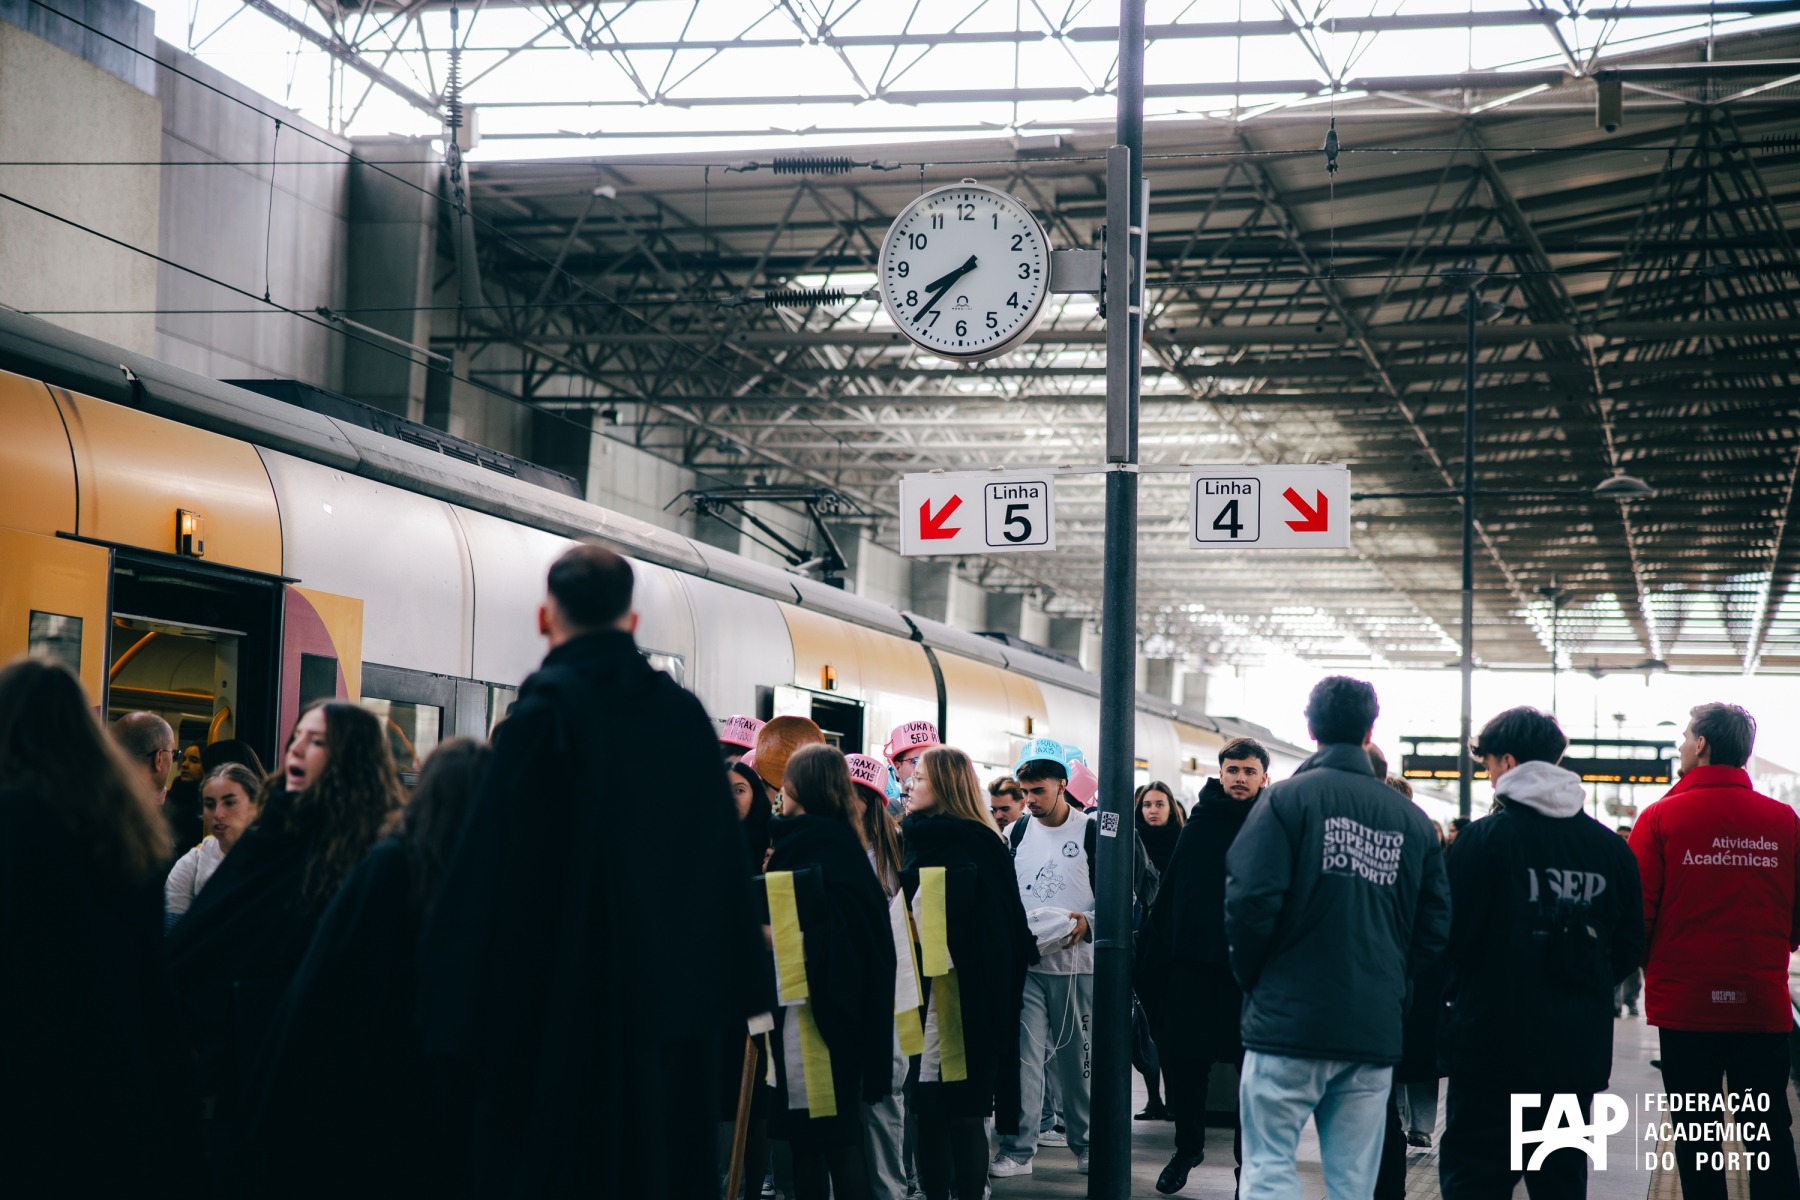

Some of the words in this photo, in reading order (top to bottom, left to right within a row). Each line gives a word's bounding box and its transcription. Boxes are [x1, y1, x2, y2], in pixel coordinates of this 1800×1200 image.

[957, 204, 975, 220] 12
[931, 213, 943, 229] 11
[992, 213, 997, 229] 1
[909, 233, 927, 250] 10
[1011, 234, 1023, 251] 2
[898, 261, 909, 278] 9
[1018, 263, 1030, 279] 3
[906, 290, 918, 306] 8
[1006, 292, 1018, 308] 4
[928, 311, 941, 327] 7
[985, 312, 997, 328] 5
[955, 320, 967, 336] 6
[994, 485, 1038, 499] Linha
[1205, 481, 1251, 494] Linha
[1003, 504, 1032, 542] 5
[1213, 500, 1243, 538] 4
[911, 732, 928, 744] SED
[850, 767, 875, 782] RAXIS
[1325, 817, 1404, 847] INSTITUTO
[1324, 830, 1401, 862] SUPERIOR
[1712, 836, 1778, 850] Atividades
[1682, 849, 1778, 867] Académicas
[1323, 854, 1348, 870] DO
[1351, 858, 1397, 885] PORTO
[1527, 868, 1606, 905] ISEP
